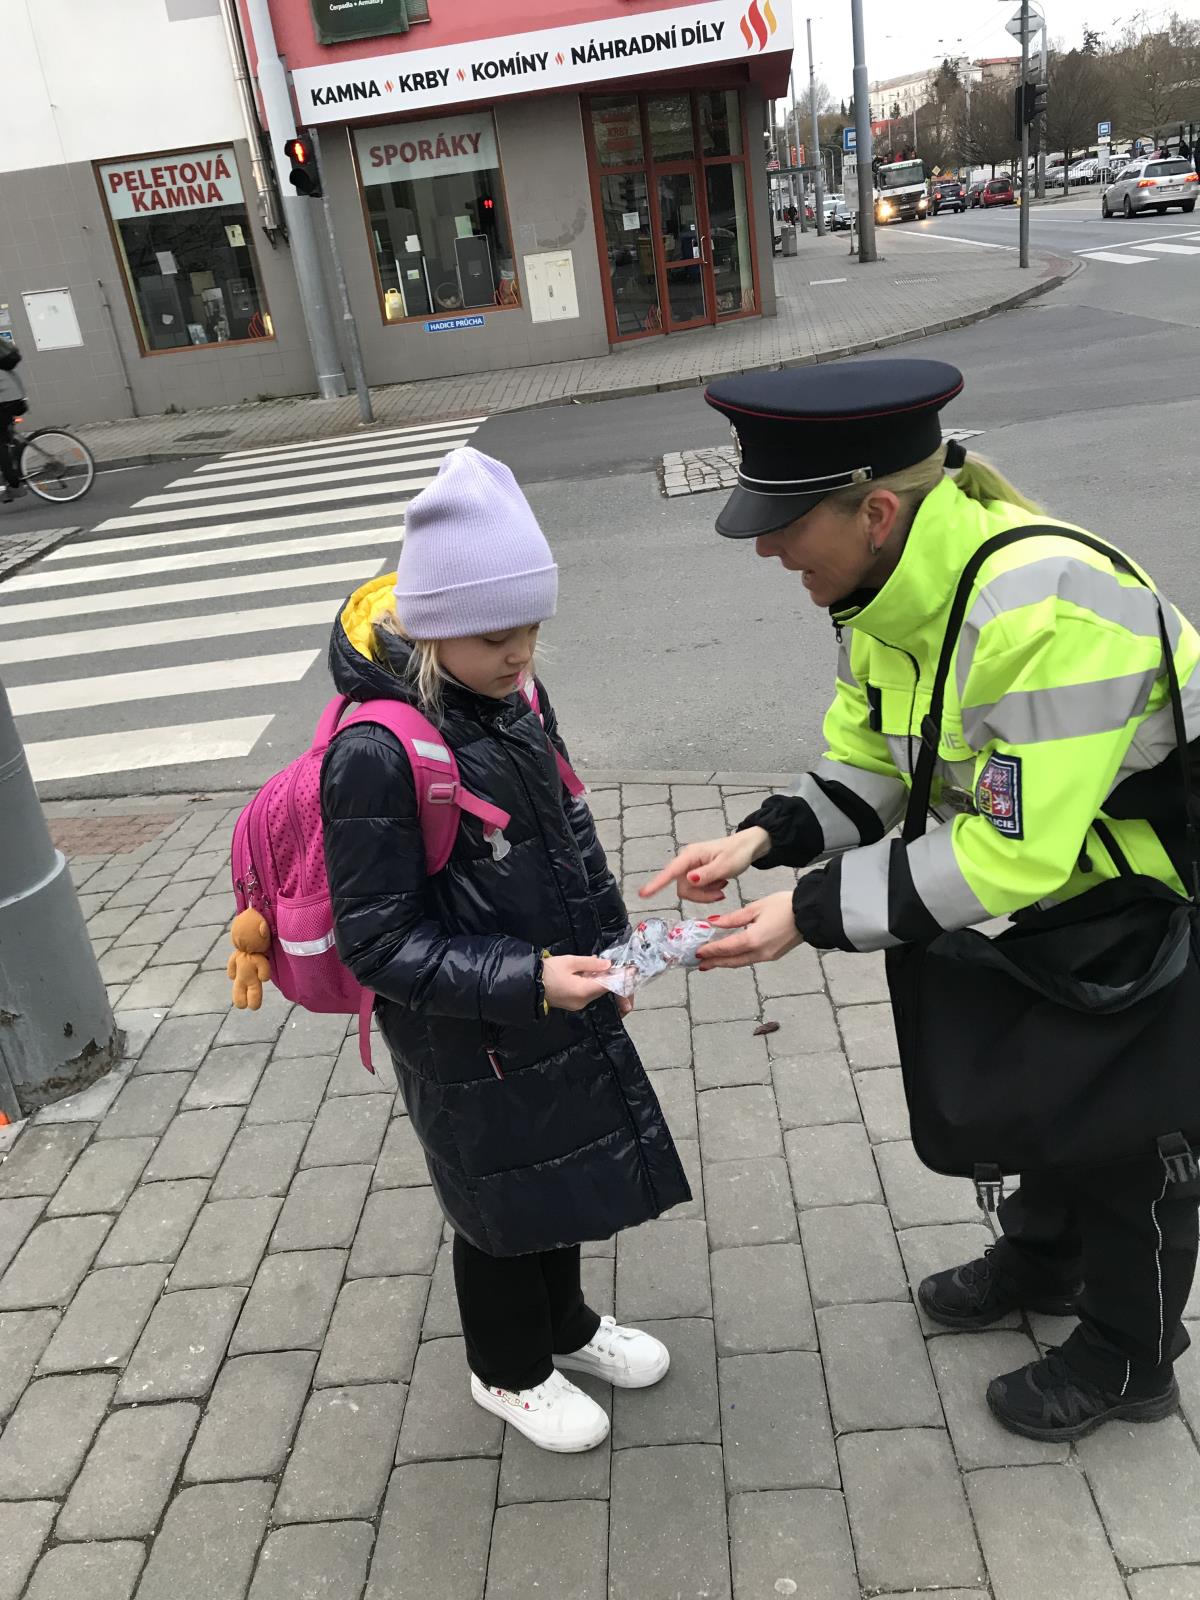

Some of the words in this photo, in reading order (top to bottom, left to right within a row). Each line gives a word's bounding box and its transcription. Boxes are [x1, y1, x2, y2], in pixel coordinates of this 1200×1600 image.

[311, 79, 382, 106] KAMNA
[399, 67, 450, 93] KRBY
[471, 52, 549, 82] KOMÍNY
[571, 25, 677, 65] NÁHRADNÍ
[681, 20, 726, 47] DÍLY
[369, 132, 482, 168] SPORÁKY
[108, 154, 231, 193] PELETOVÁ
[131, 182, 223, 212] KAMNA
[430, 322, 455, 330] HADICE
